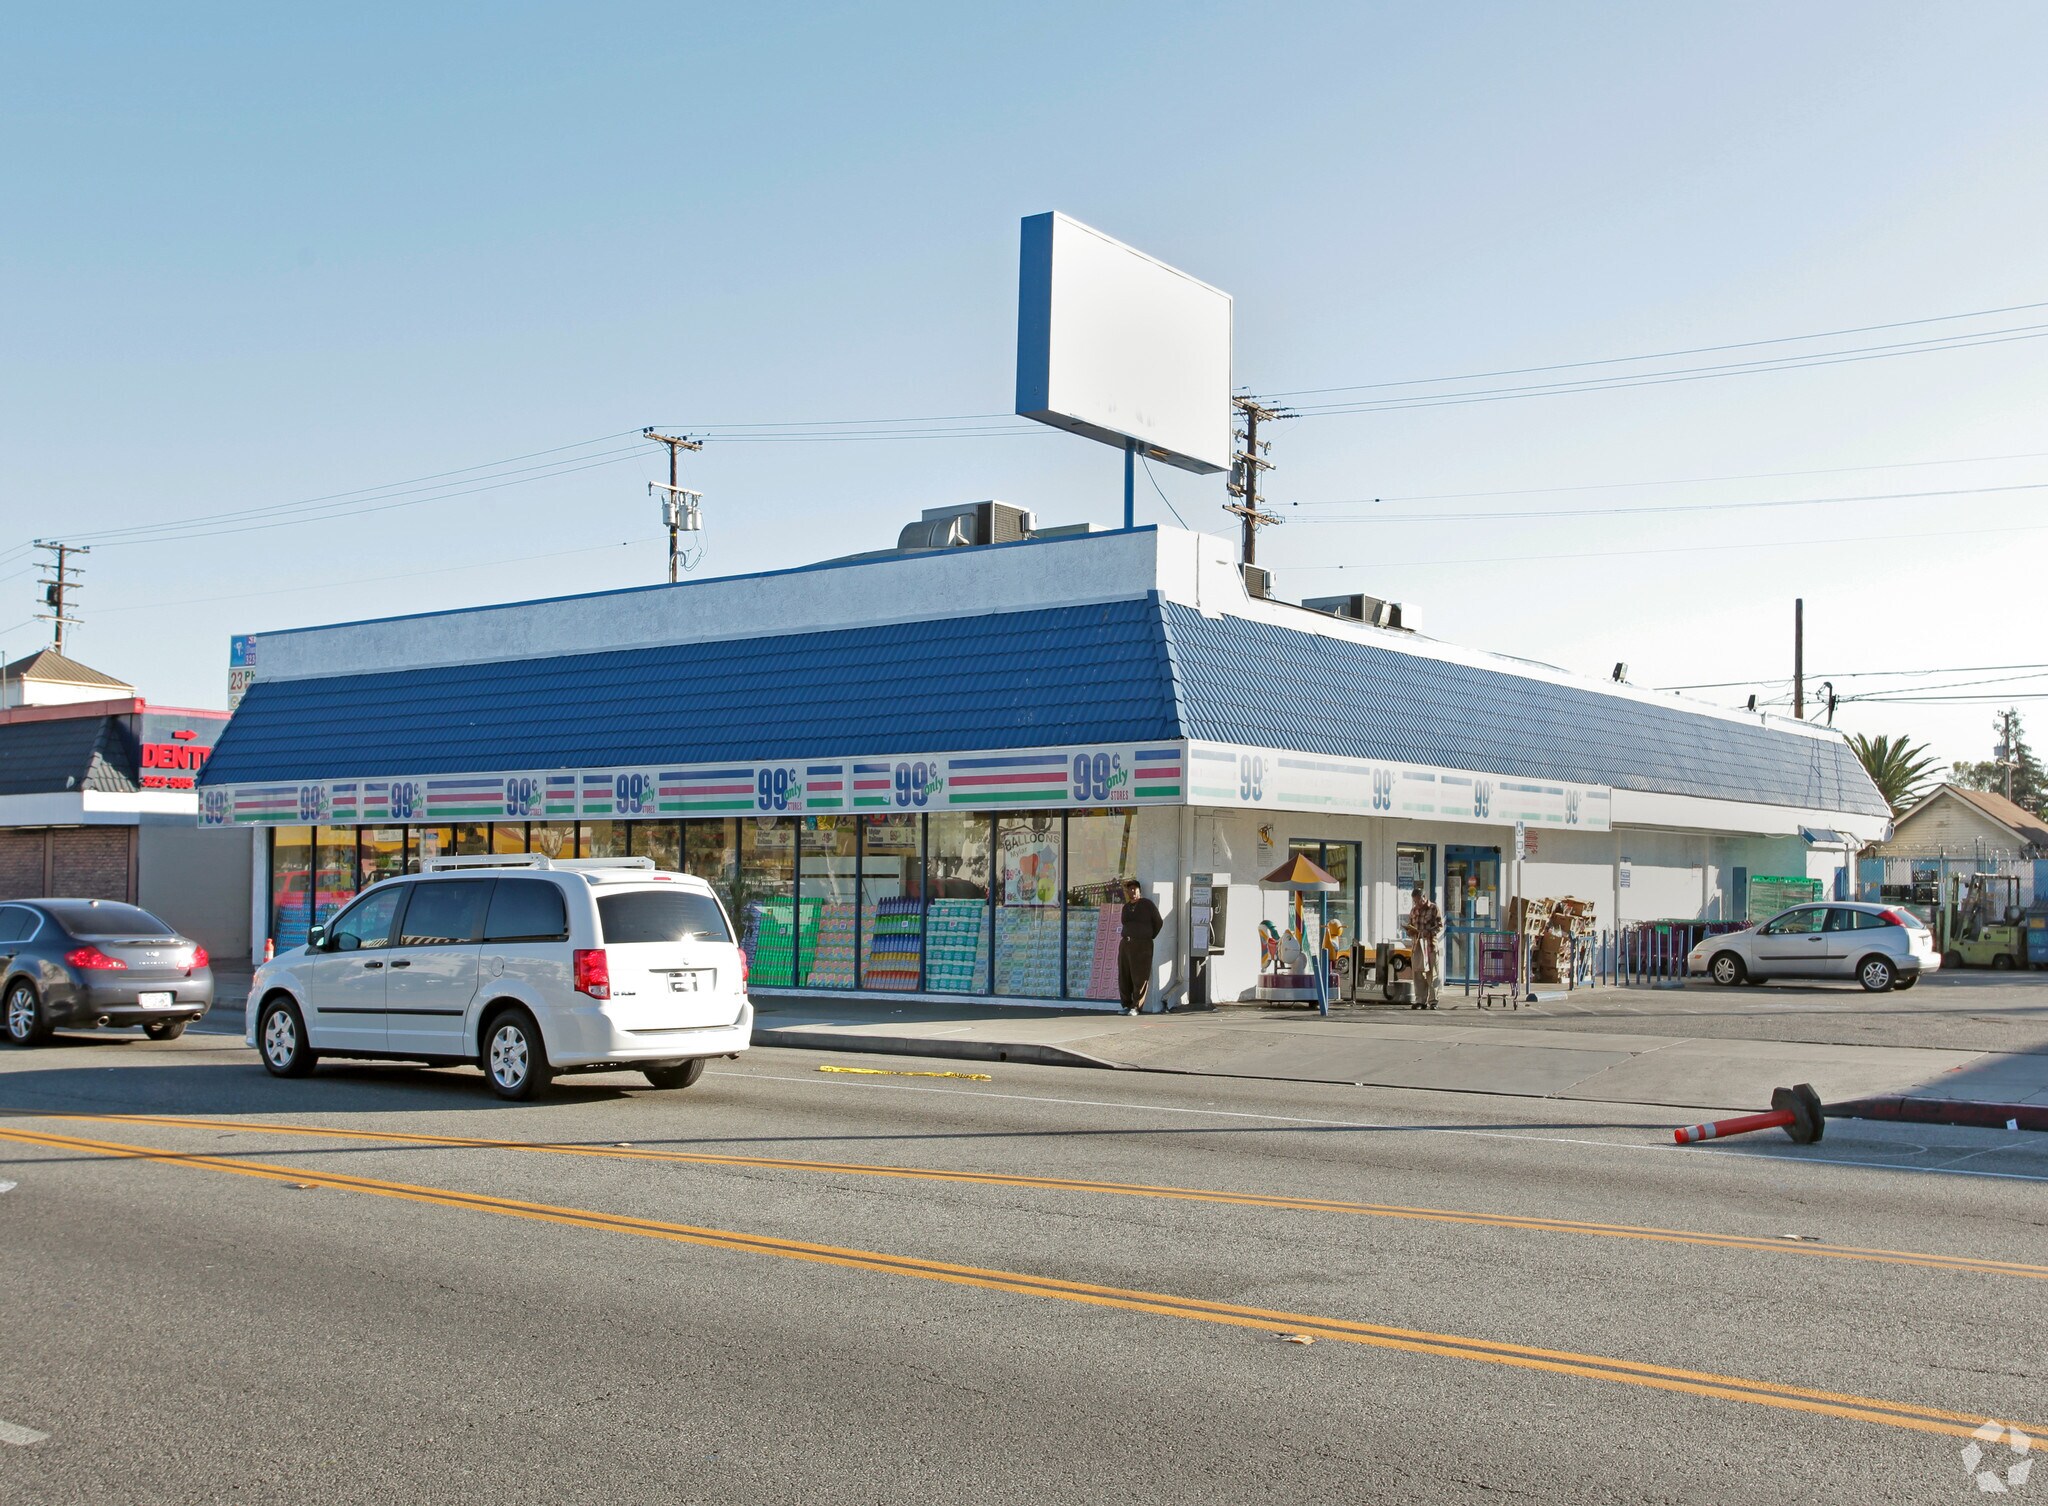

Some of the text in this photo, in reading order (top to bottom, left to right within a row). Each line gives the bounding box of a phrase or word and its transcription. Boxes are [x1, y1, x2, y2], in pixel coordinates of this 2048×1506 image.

[230, 671, 243, 690] 23
[895, 761, 937, 807] 99¢
[924, 776, 944, 796] only
[1073, 752, 1121, 801] 99¢
[1106, 768, 1128, 790] only
[507, 778, 537, 816] 99¢
[616, 772, 650, 814] 99¢
[639, 786, 655, 804] only
[758, 767, 796, 811] 99¢
[783, 782, 802, 801] only
[1110, 790, 1129, 801] STORES
[391, 782, 419, 819] 99¢
[787, 802, 802, 811] STORES
[1004, 833, 1060, 852] BALLOONS
